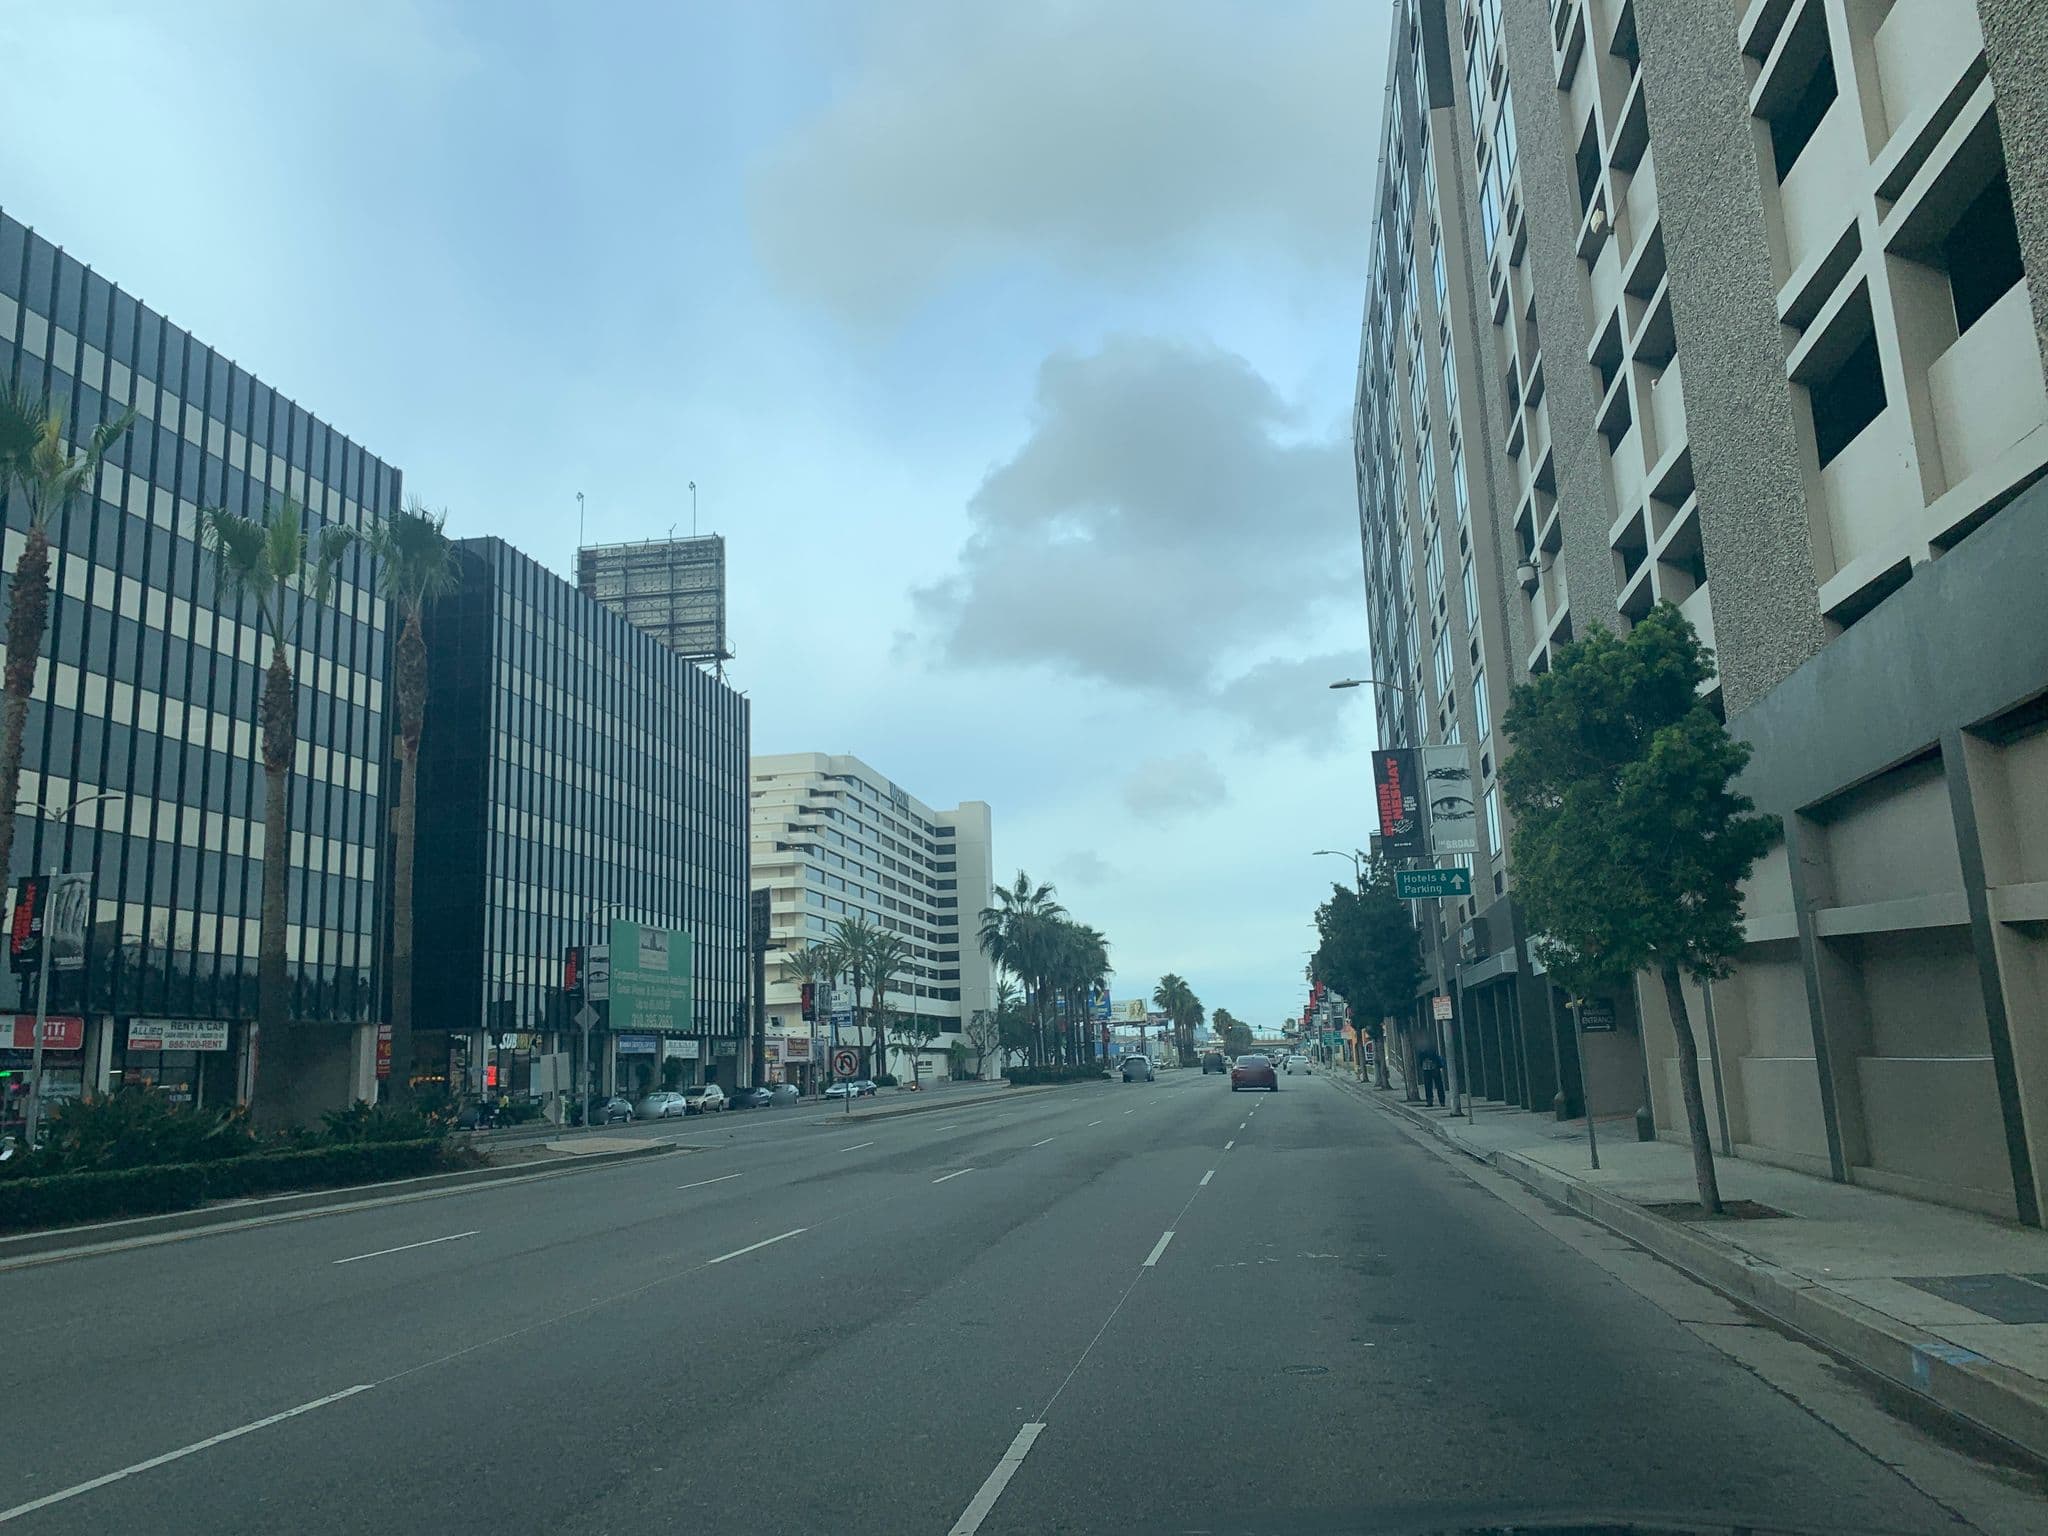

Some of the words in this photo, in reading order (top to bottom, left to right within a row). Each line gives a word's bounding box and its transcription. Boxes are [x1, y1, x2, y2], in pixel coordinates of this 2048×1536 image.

[1386, 757, 1404, 821] NESHAT
[1378, 783, 1395, 838] SHIRIN
[1446, 839, 1475, 849] BROAD
[1404, 873, 1437, 883] Hotels
[1441, 873, 1447, 882] &
[1405, 884, 1442, 895] Parking
[170, 1021, 194, 1031] RENT
[198, 1023, 204, 1031] A
[206, 1023, 224, 1031] CAR
[131, 1027, 163, 1036] ALLIED
